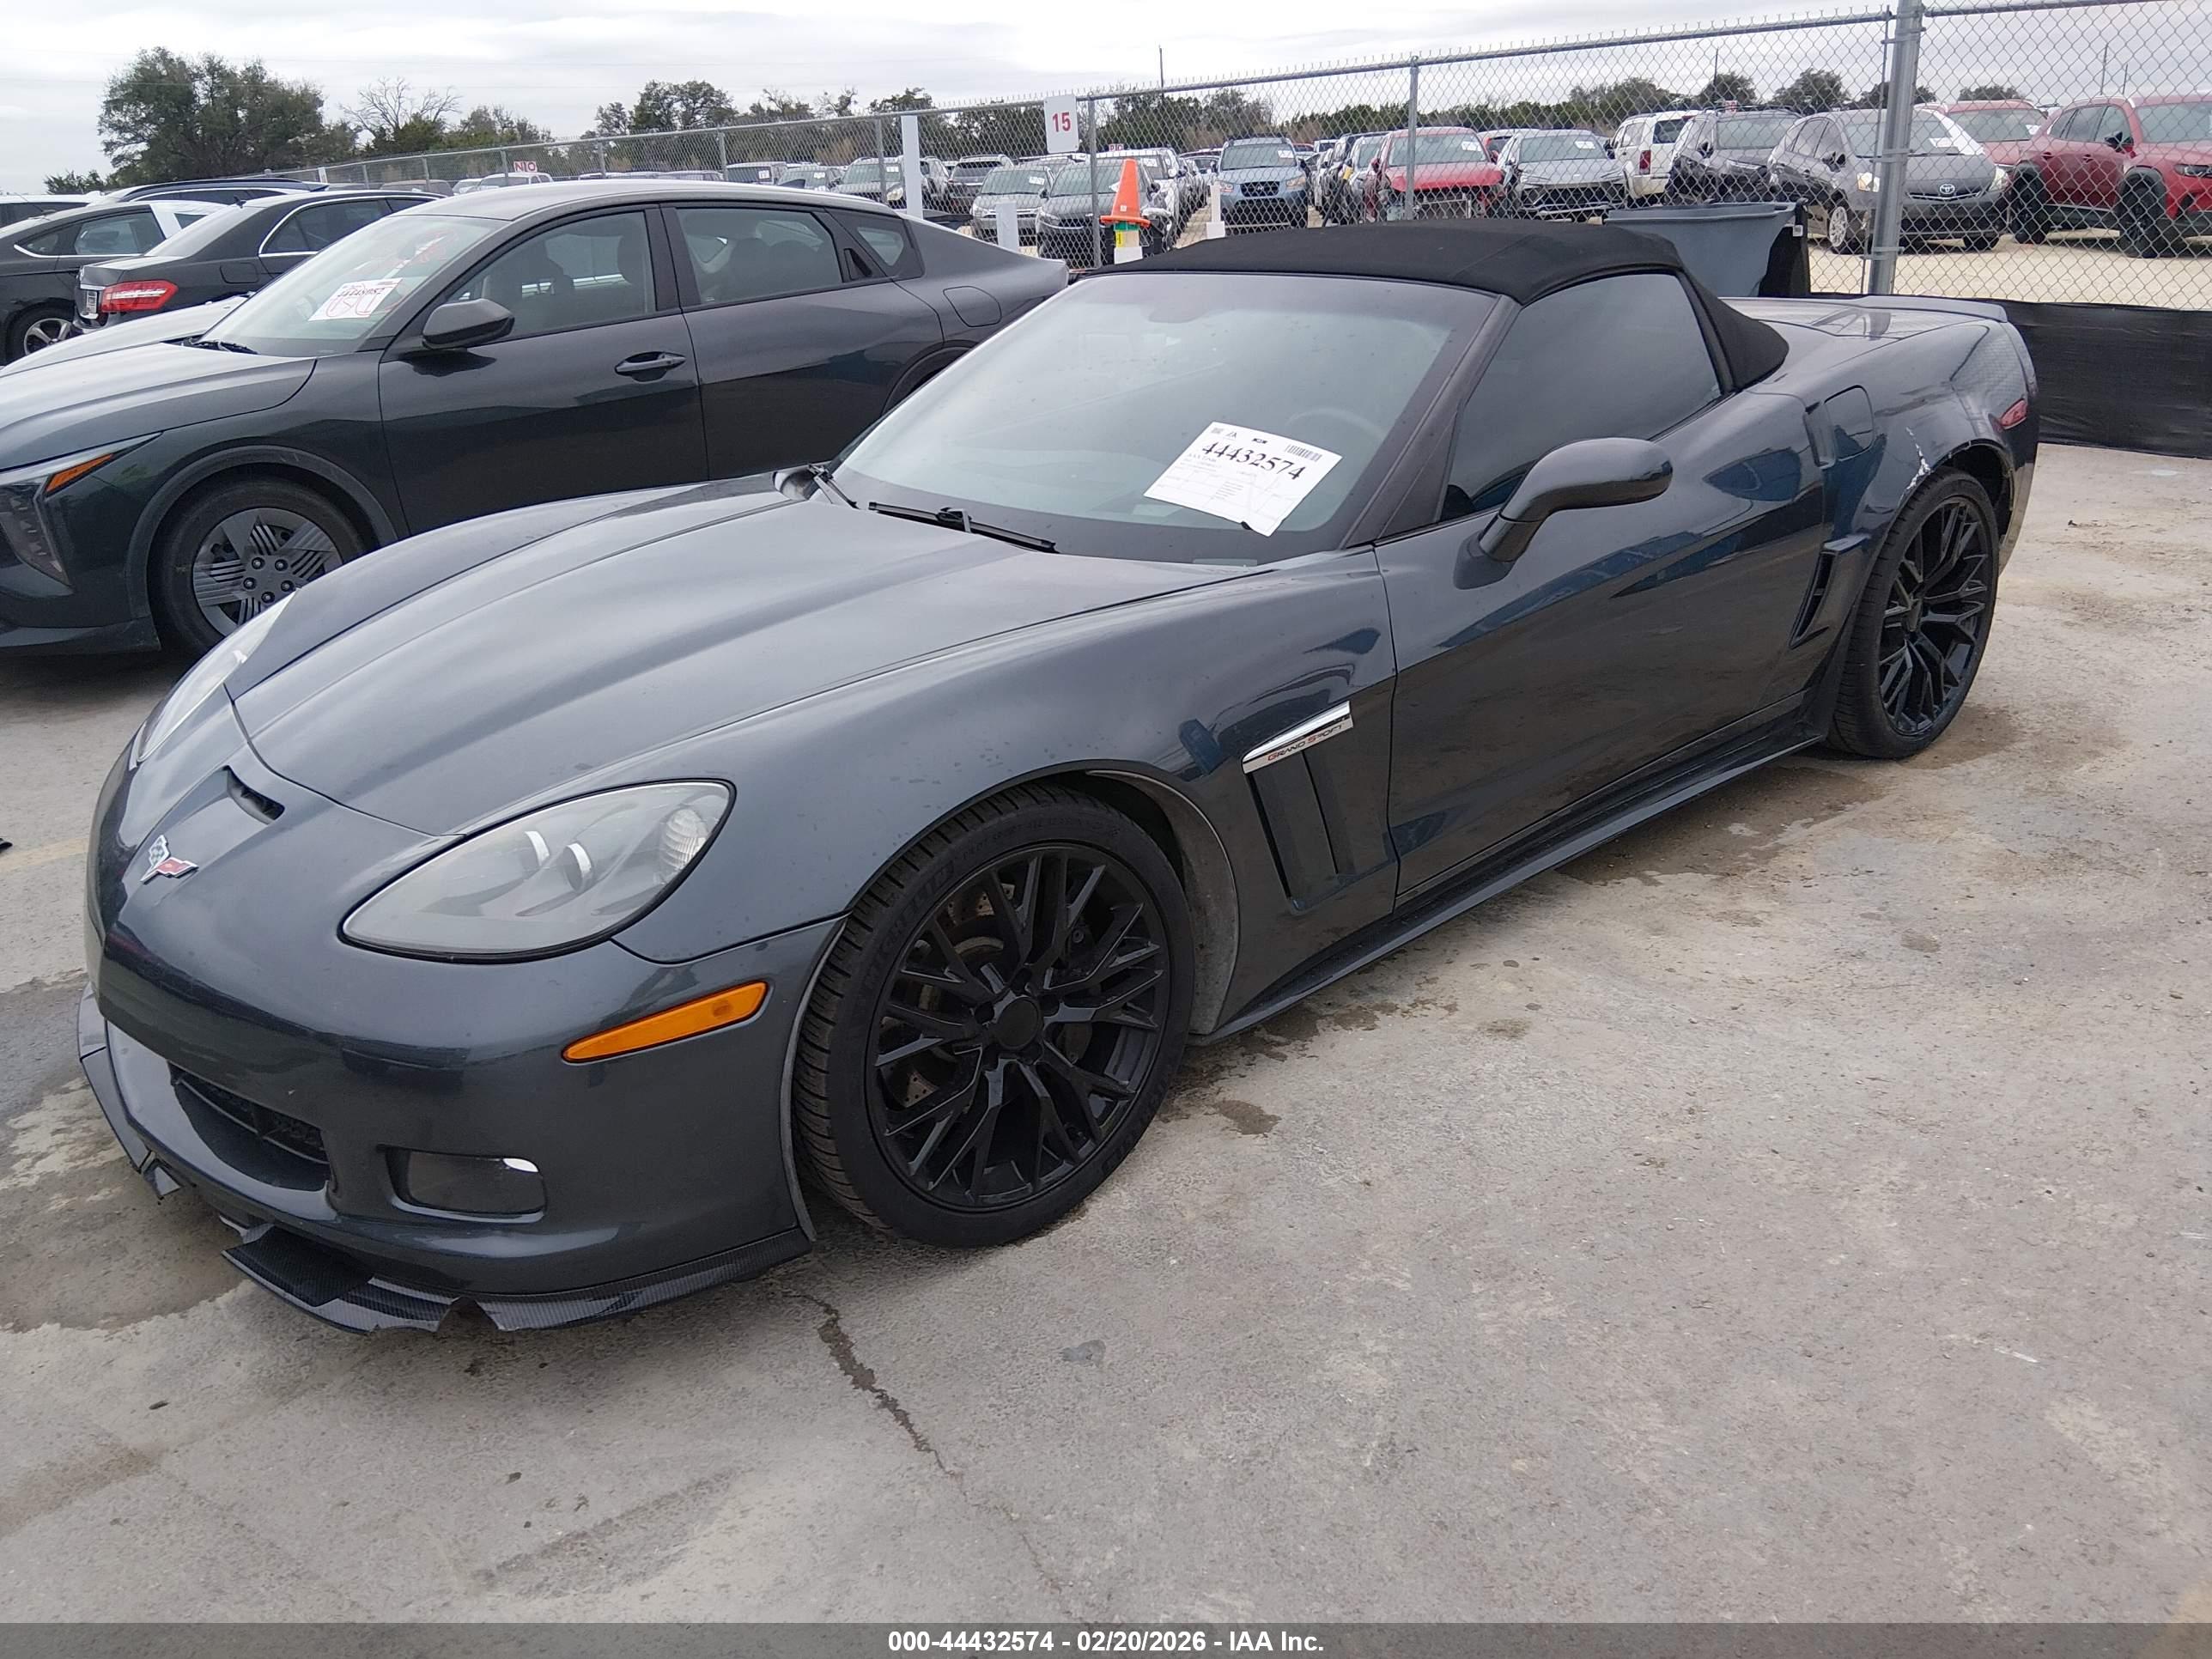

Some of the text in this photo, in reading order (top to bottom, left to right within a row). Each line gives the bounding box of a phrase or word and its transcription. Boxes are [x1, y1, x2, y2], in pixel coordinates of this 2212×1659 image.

[1052, 112, 1071, 131] 15
[1202, 442, 1306, 480] 44432574
[1267, 741, 1305, 761] GRAND
